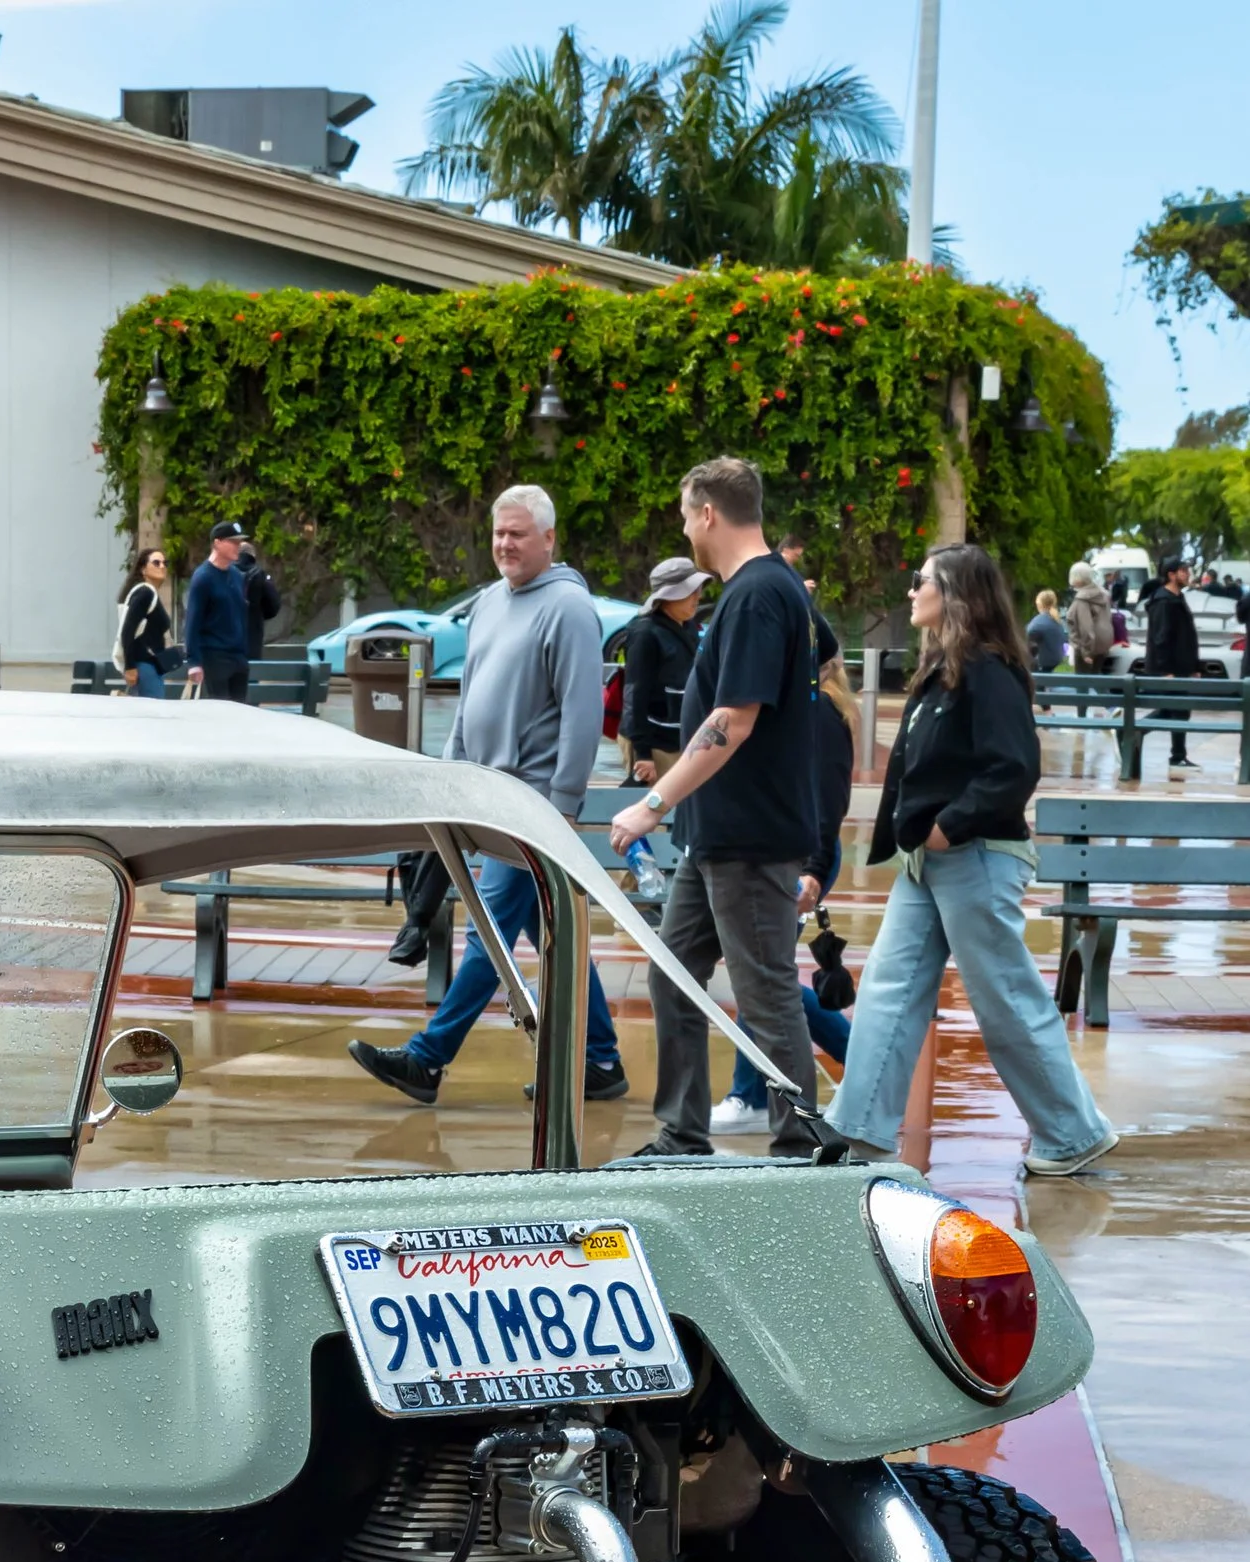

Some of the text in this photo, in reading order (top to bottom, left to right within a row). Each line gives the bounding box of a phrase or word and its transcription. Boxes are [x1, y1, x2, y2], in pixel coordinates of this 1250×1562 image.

[403, 1224, 562, 1250] MEYERS MANX
[588, 1236, 618, 1249] 2025
[344, 1248, 381, 1271] SEP
[398, 1250, 589, 1287] California
[369, 1281, 656, 1372] 9MYM820
[480, 1374, 575, 1402] MEYERS
[585, 1371, 603, 1394] &
[611, 1367, 650, 1392] CO.
